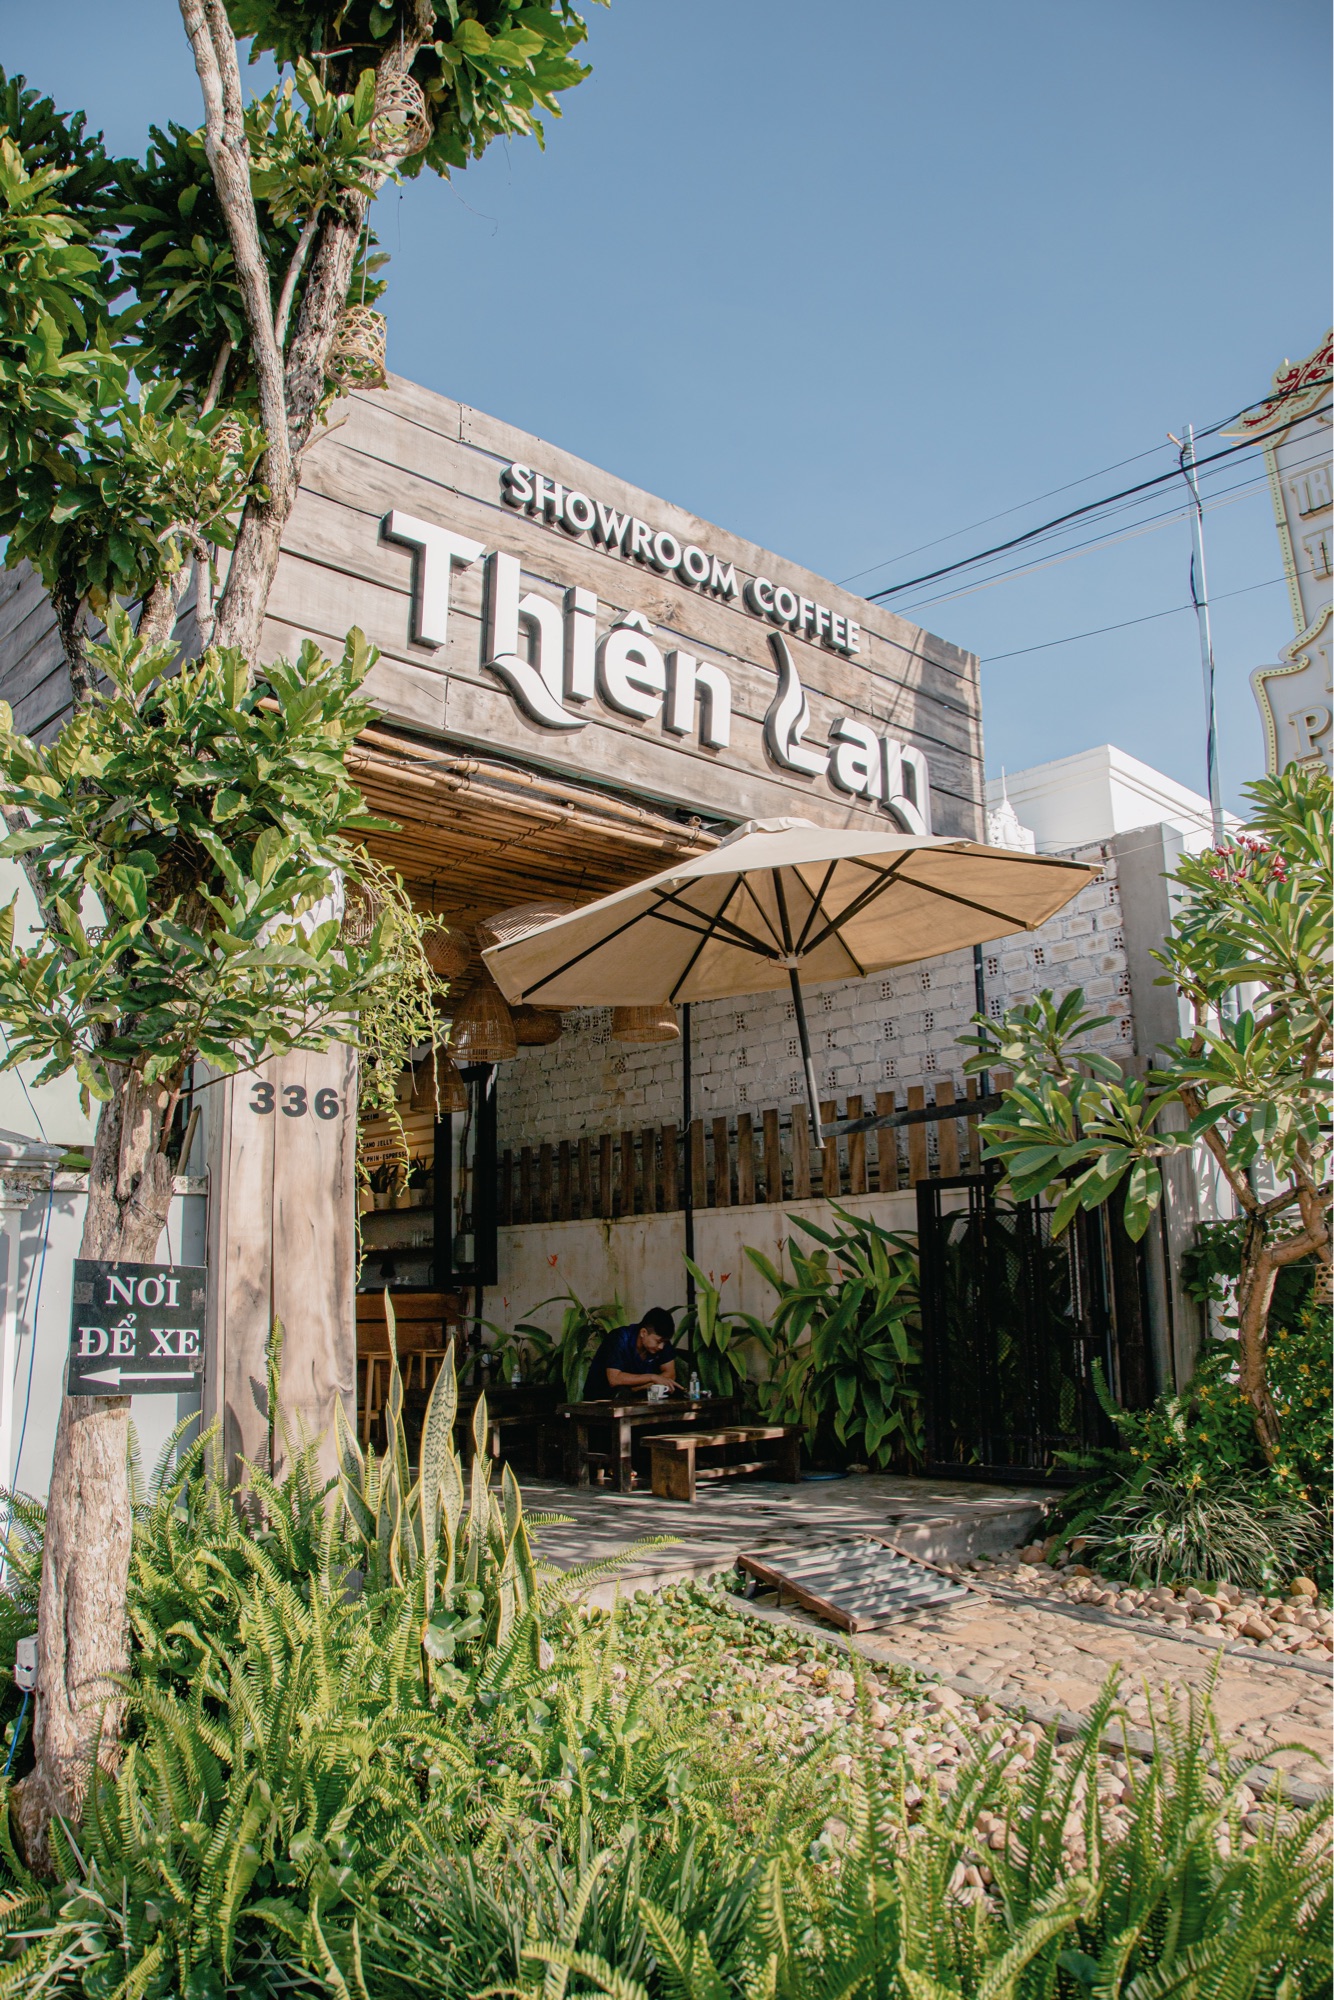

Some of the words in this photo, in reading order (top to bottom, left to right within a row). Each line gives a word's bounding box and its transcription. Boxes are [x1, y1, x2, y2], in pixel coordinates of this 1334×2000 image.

[502, 462, 738, 600] SHOWROOM
[745, 576, 861, 656] COFFEE
[380, 509, 732, 750] Thiên
[764, 631, 932, 836] Lan
[249, 1081, 340, 1121] 336
[377, 1138, 393, 1147] JELLY
[105, 1273, 181, 1307] NƠI
[77, 1313, 137, 1357] ĐỂ
[149, 1327, 201, 1357] XE
